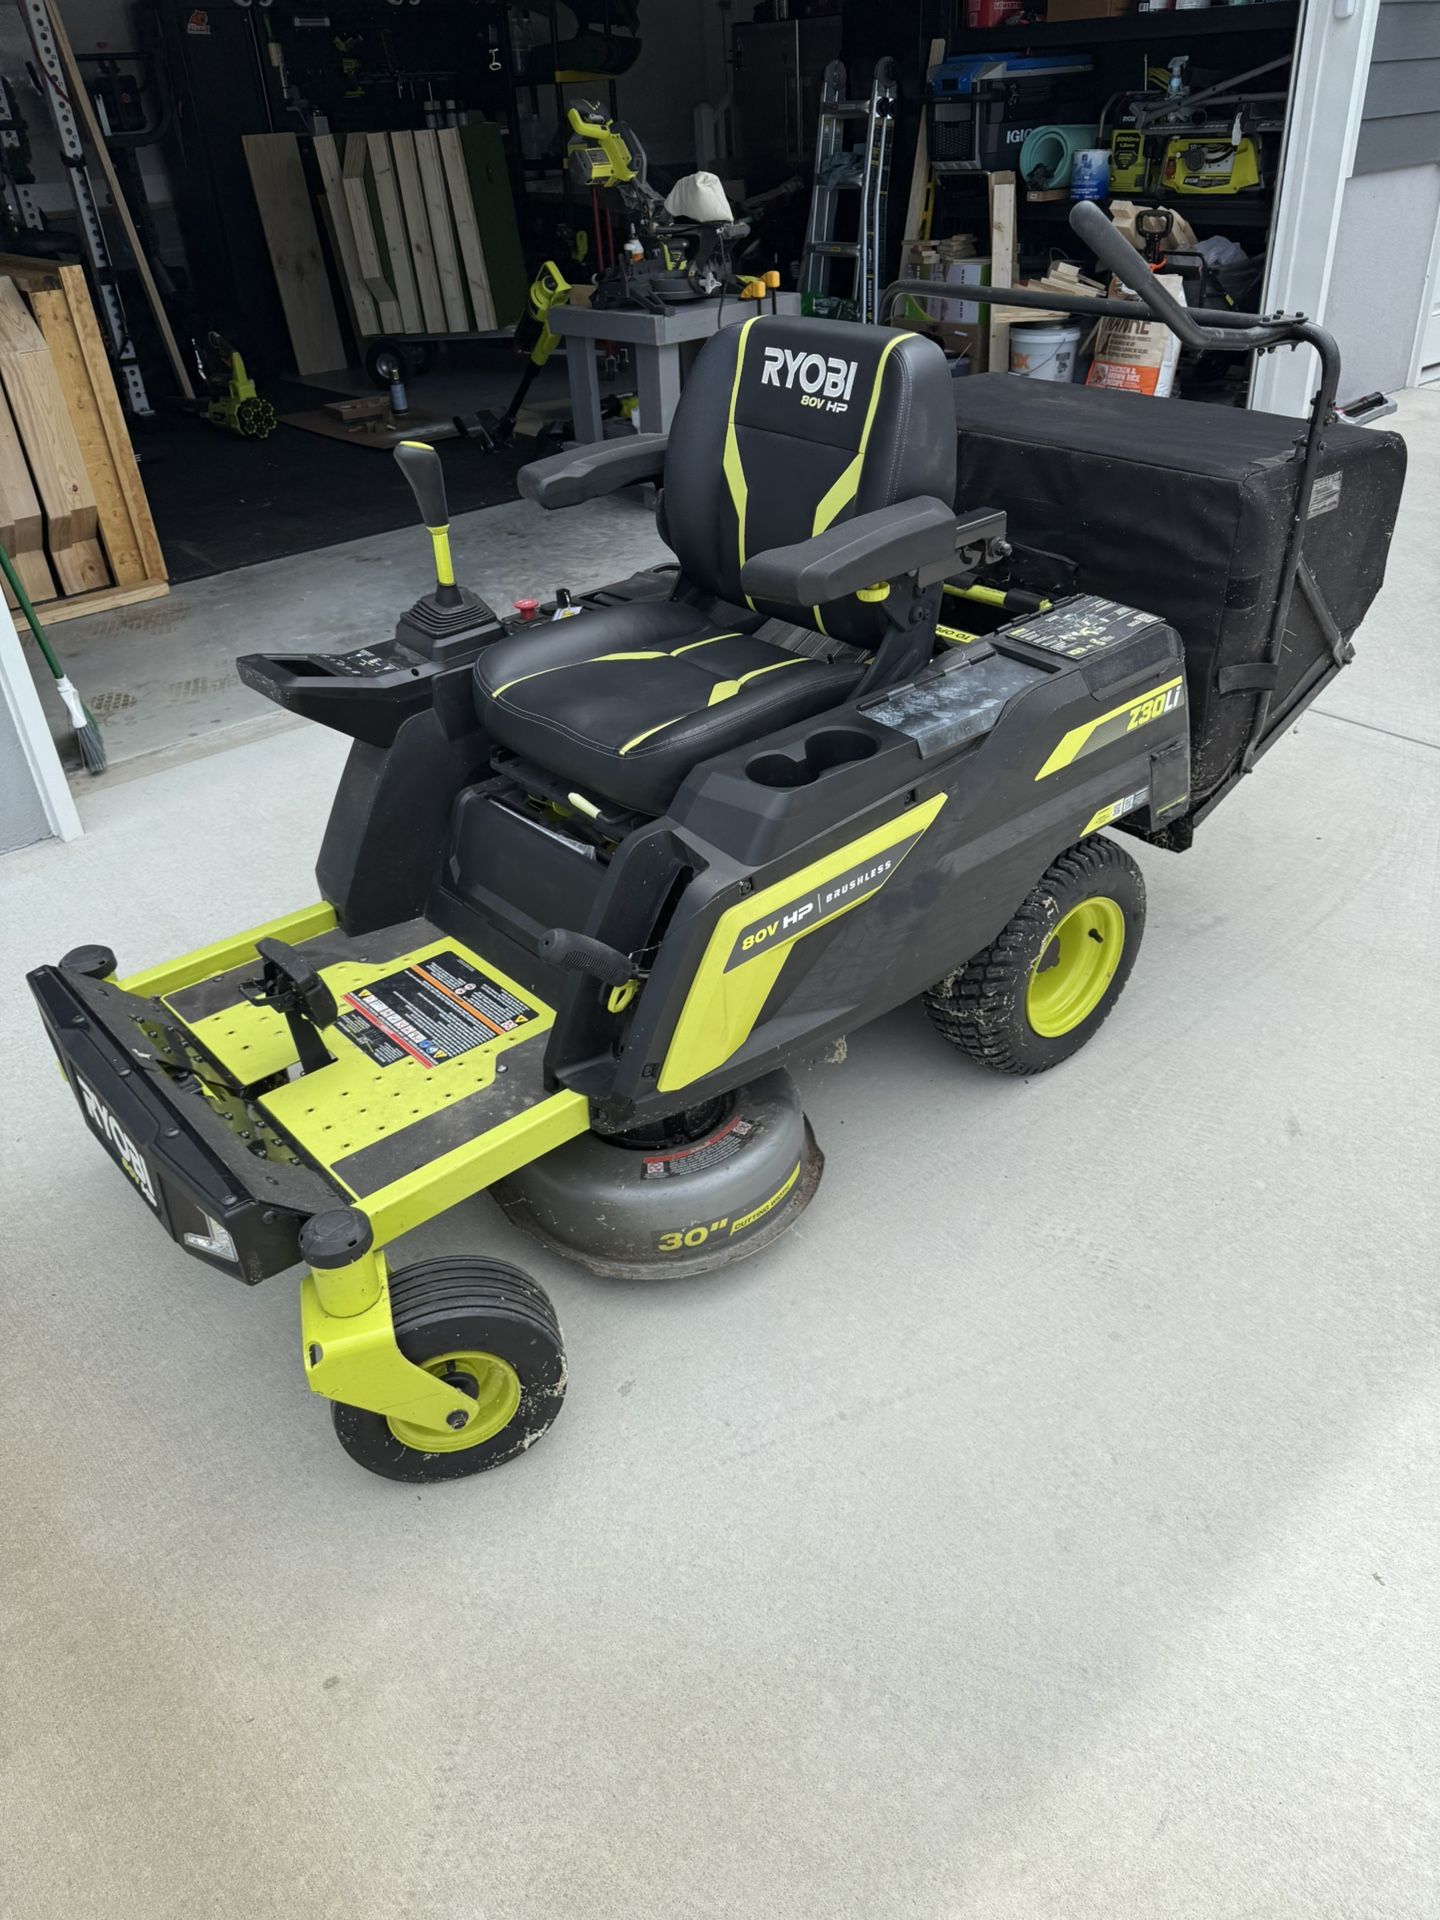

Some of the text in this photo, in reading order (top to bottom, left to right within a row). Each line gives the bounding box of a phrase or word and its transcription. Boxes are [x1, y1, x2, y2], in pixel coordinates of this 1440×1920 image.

[761, 347, 858, 401] RYOBI
[800, 394, 849, 413] 80V HP
[1127, 686, 1181, 731] Z30Li
[742, 859, 893, 951] 80V HP BRUSHLESS
[76, 1075, 155, 1199] RYOBI
[657, 1217, 728, 1253] 30"
